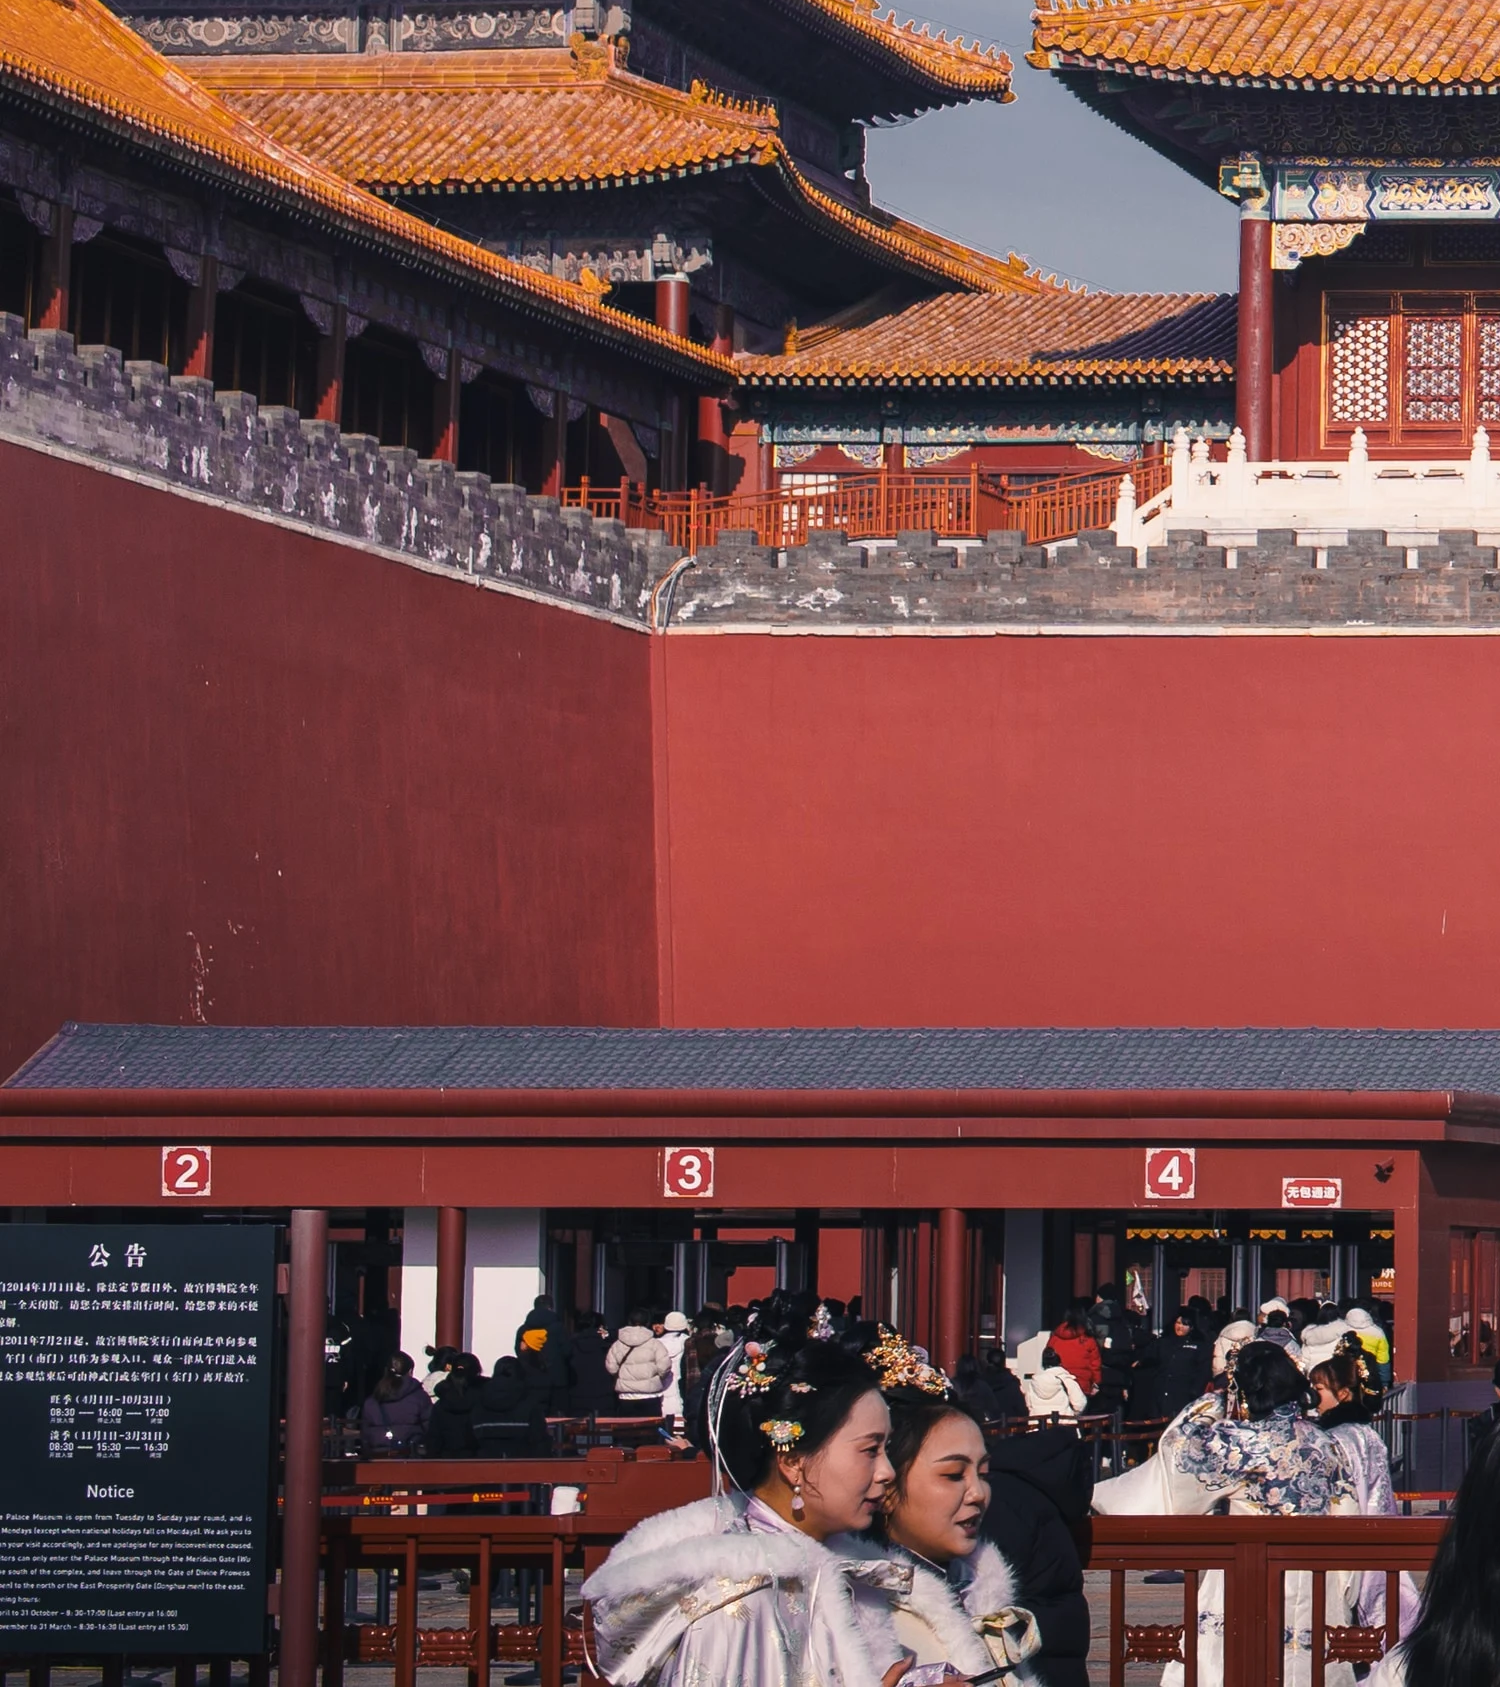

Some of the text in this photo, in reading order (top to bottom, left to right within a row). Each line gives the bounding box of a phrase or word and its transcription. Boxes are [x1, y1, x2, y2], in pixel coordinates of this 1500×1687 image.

[175, 1154, 198, 1188] 2
[678, 1155, 702, 1189] 3
[1158, 1156, 1183, 1190] 4
[1287, 1186, 1336, 1199] 无包通道
[88, 1243, 147, 1268] 公告
[50, 1408, 169, 1417] 08:30 16:00 17:00
[49, 1443, 168, 1452] 08:30 15:30 16:30
[87, 1484, 134, 1498] Notice
